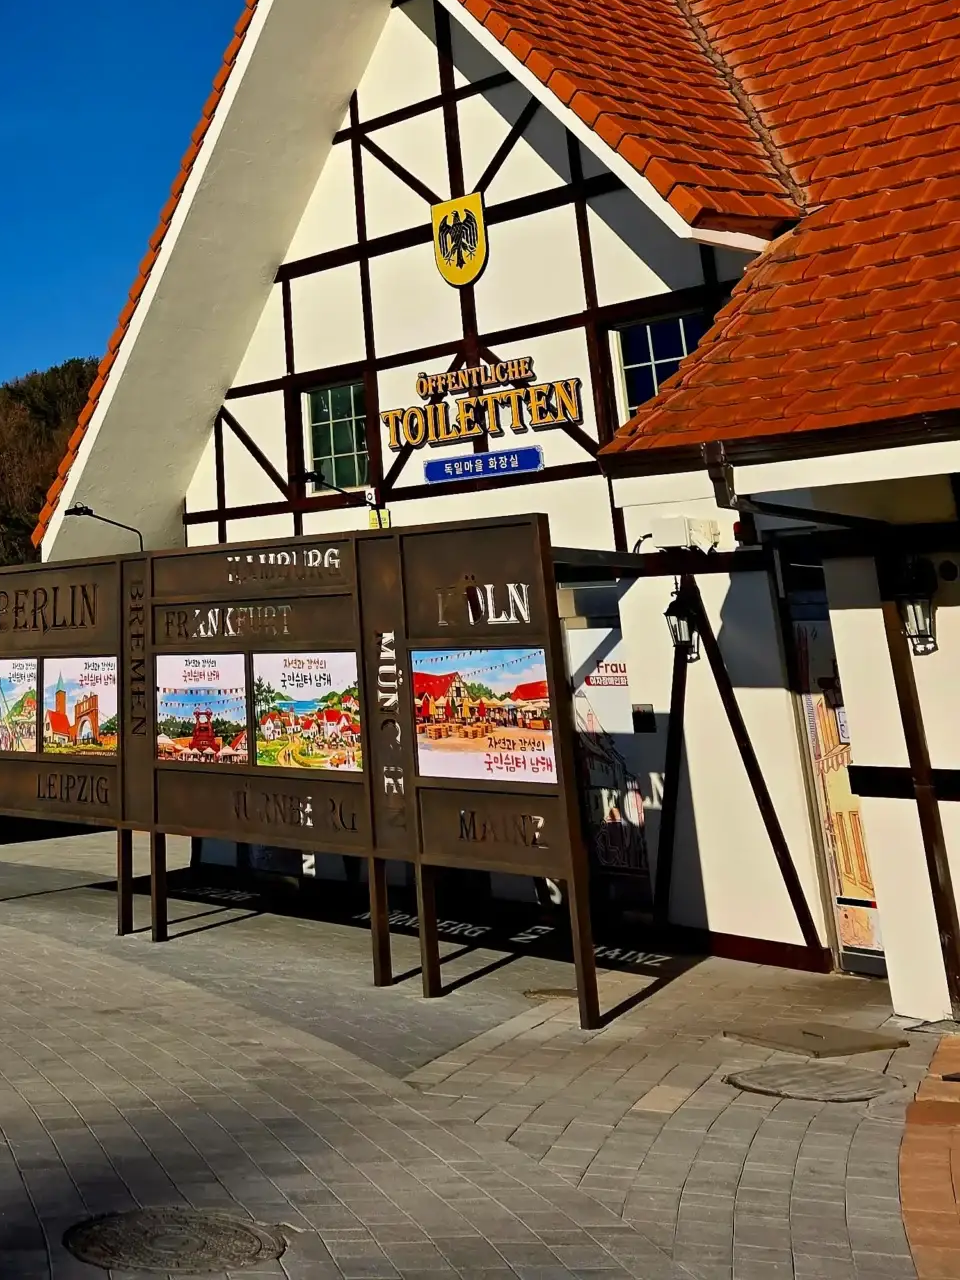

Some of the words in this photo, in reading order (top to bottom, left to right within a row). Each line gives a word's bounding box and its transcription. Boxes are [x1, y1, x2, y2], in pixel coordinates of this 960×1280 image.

[416, 357, 535, 399] ÖFFENTLICHE
[381, 378, 584, 451] TOILETTEN
[444, 459, 483, 475] 독일마을
[488, 454, 519, 470] 화장실
[227, 548, 342, 585] HAMBURG
[164, 605, 292, 639] FRANKFURT
[129, 580, 147, 737] BREMEN
[283, 658, 305, 670] 자연과
[306, 658, 327, 670] 감성의
[596, 659, 627, 673] Frau
[280, 673, 312, 690] 국민쉼터
[487, 736, 517, 751] 자연과
[518, 737, 546, 752] 감성의
[484, 753, 527, 773] 국민쉼터
[530, 756, 553, 773] 남해
[37, 773, 110, 806] LEIPZIG
